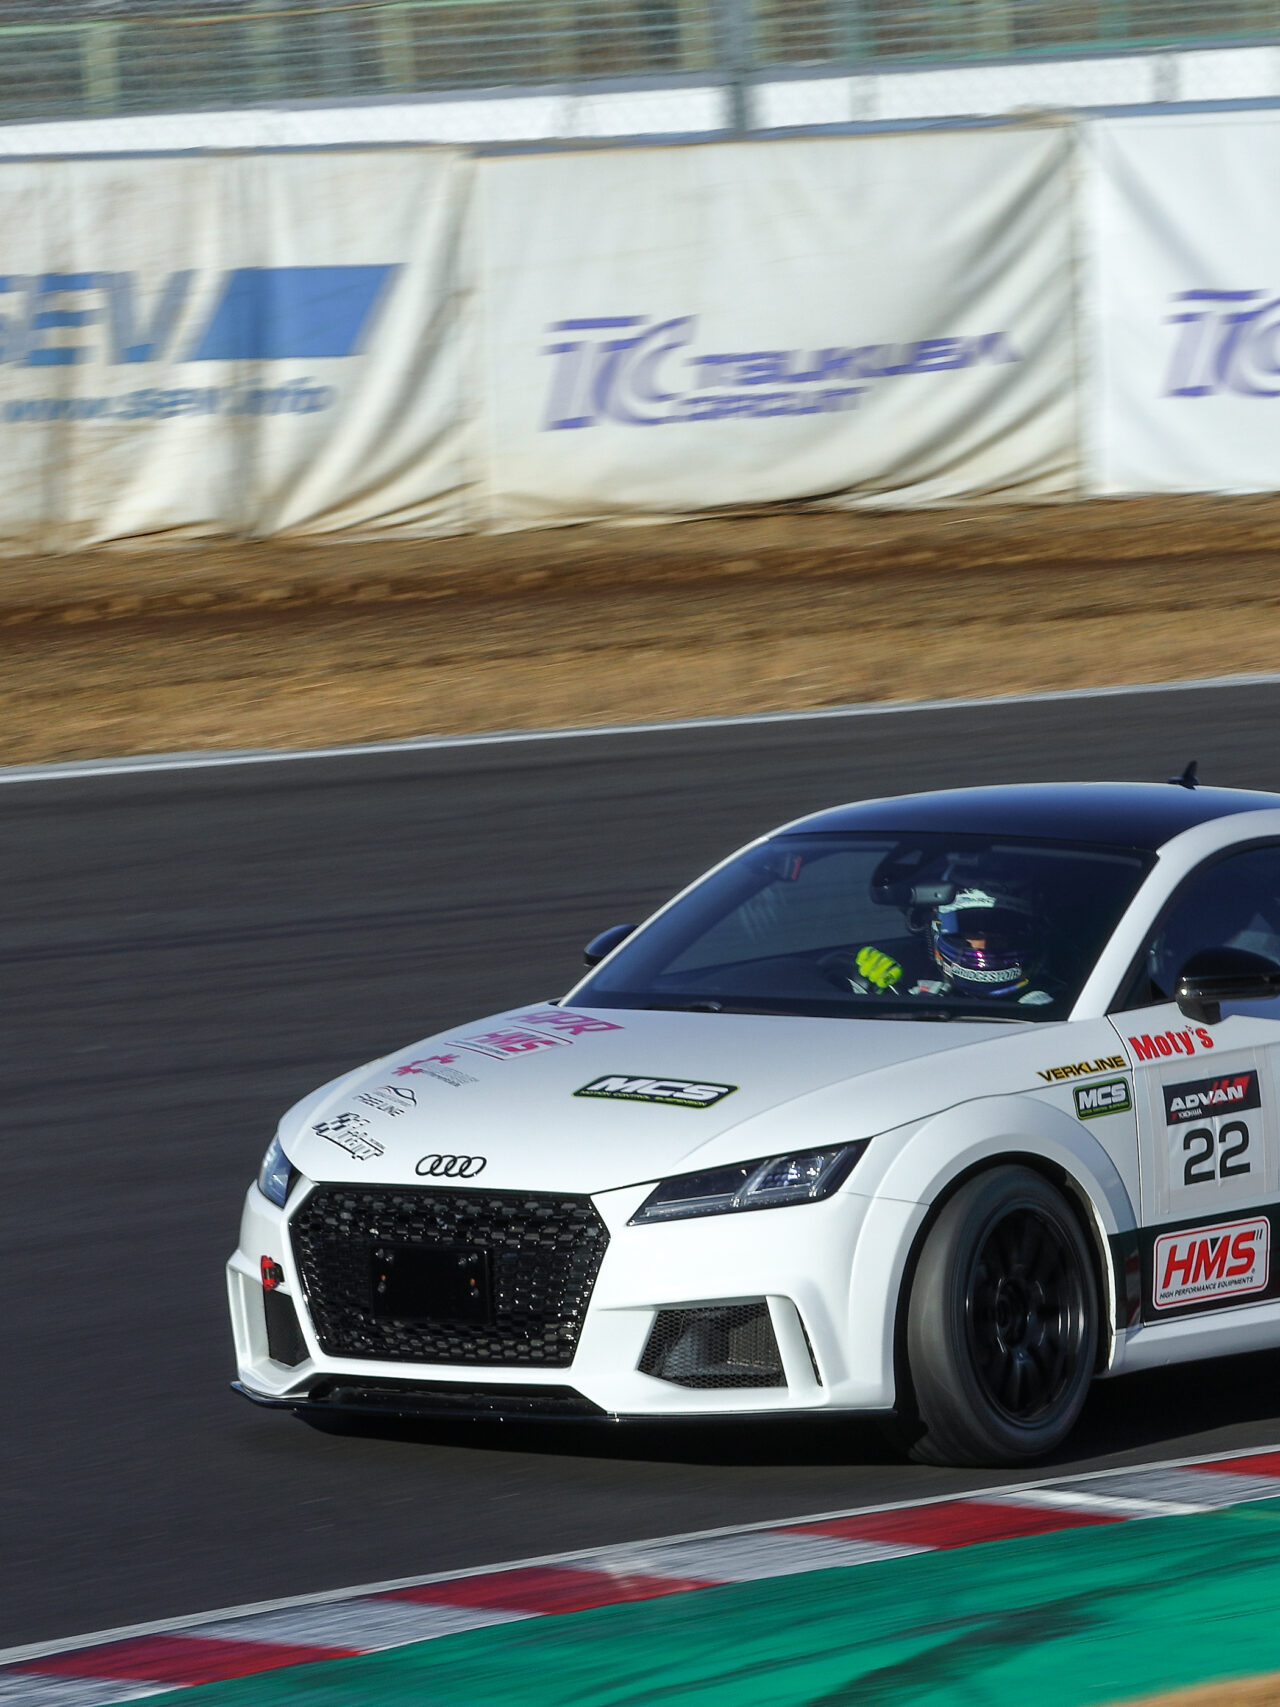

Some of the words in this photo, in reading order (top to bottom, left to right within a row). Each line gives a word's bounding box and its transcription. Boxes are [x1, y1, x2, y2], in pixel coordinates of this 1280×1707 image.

[540, 313, 700, 432] TC
[505, 1011, 625, 1035] APR
[463, 1028, 557, 1053] HMS
[1128, 1025, 1214, 1061] Moty's
[1037, 1055, 1126, 1082] VERKLINE
[587, 1077, 728, 1100] MCS
[1078, 1083, 1126, 1110] MCS
[1170, 1085, 1243, 1112] ADVAN
[1183, 1120, 1250, 1186] 22
[1162, 1229, 1258, 1289] HMS
